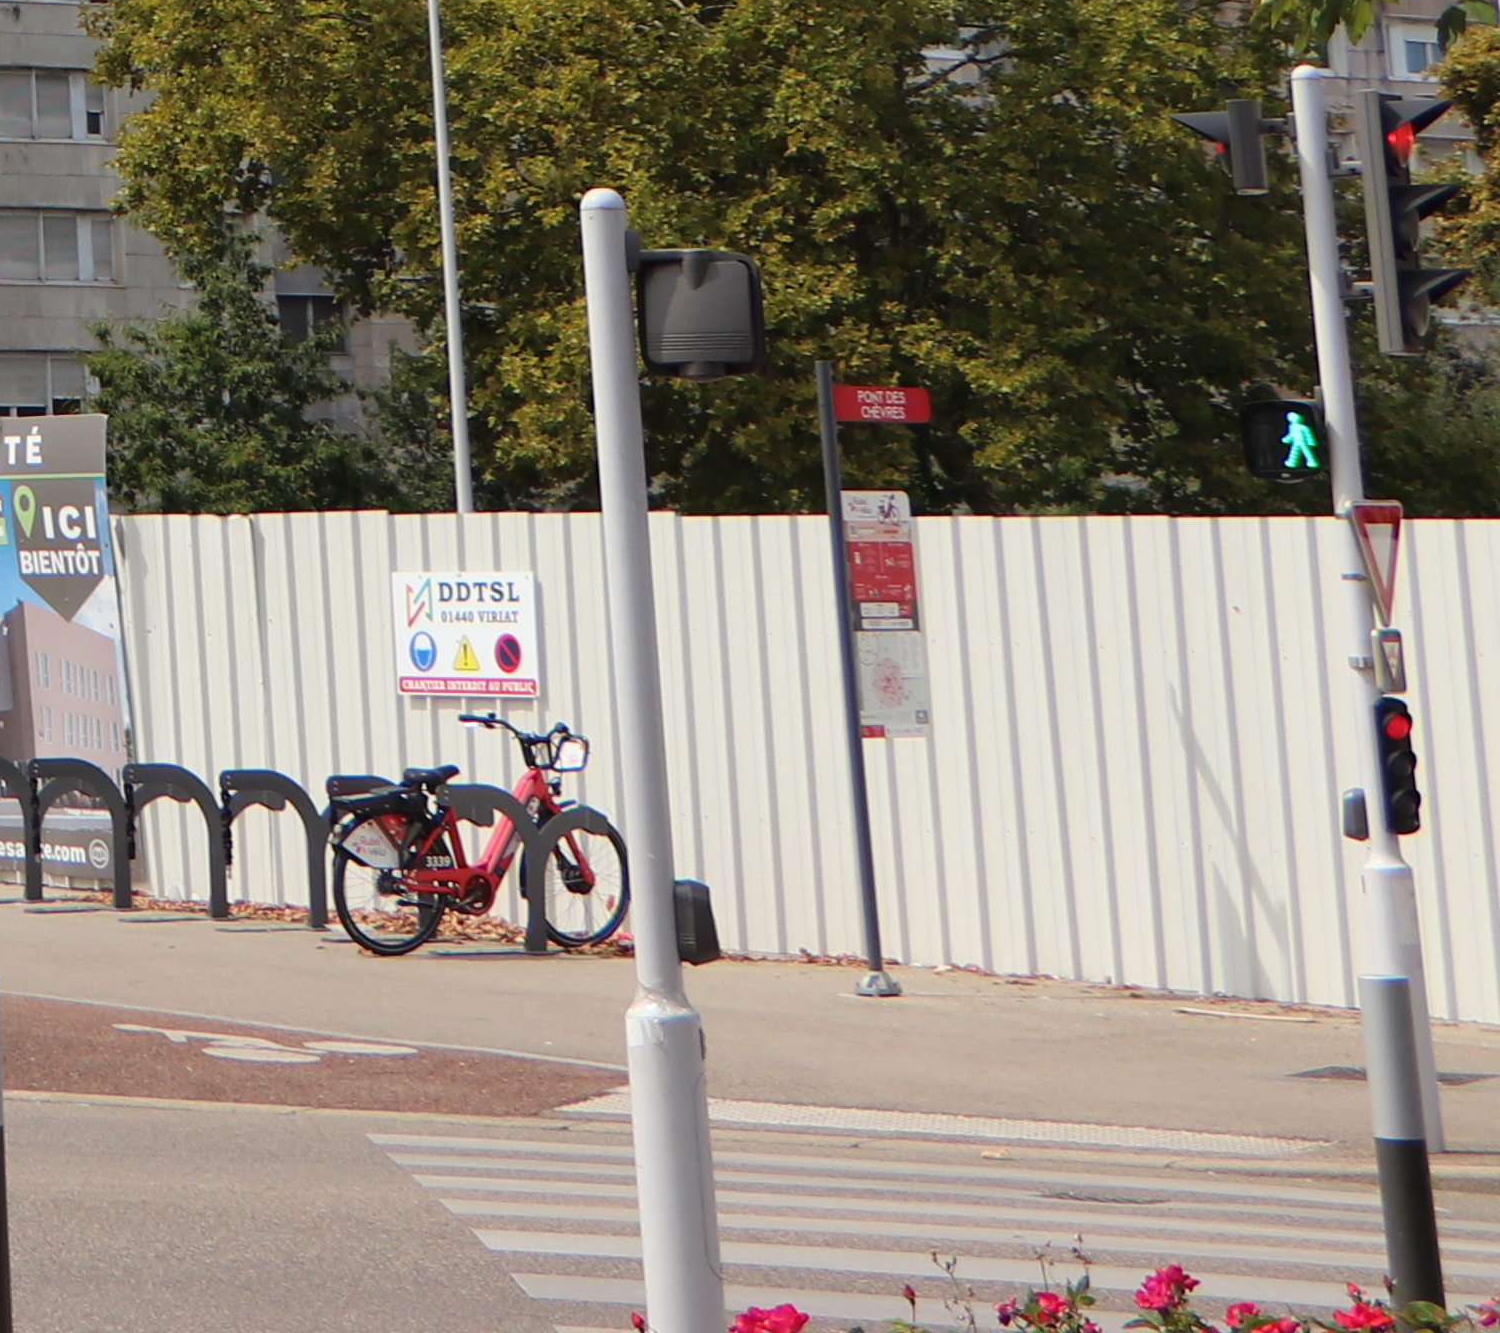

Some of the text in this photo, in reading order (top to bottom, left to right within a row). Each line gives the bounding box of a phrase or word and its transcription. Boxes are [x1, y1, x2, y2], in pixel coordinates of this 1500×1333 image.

[857, 390, 906, 405] PONT DES
[860, 402, 907, 420] CHÈVRES
[42, 504, 97, 540] ICI
[19, 542, 101, 575] BIENTÔT
[438, 581, 521, 603] DDTSL
[441, 610, 519, 624] 01440 VIRIAT
[402, 679, 535, 694] CHANTIER INTERDIT AU PUBLIC
[425, 854, 452, 868] 3339
